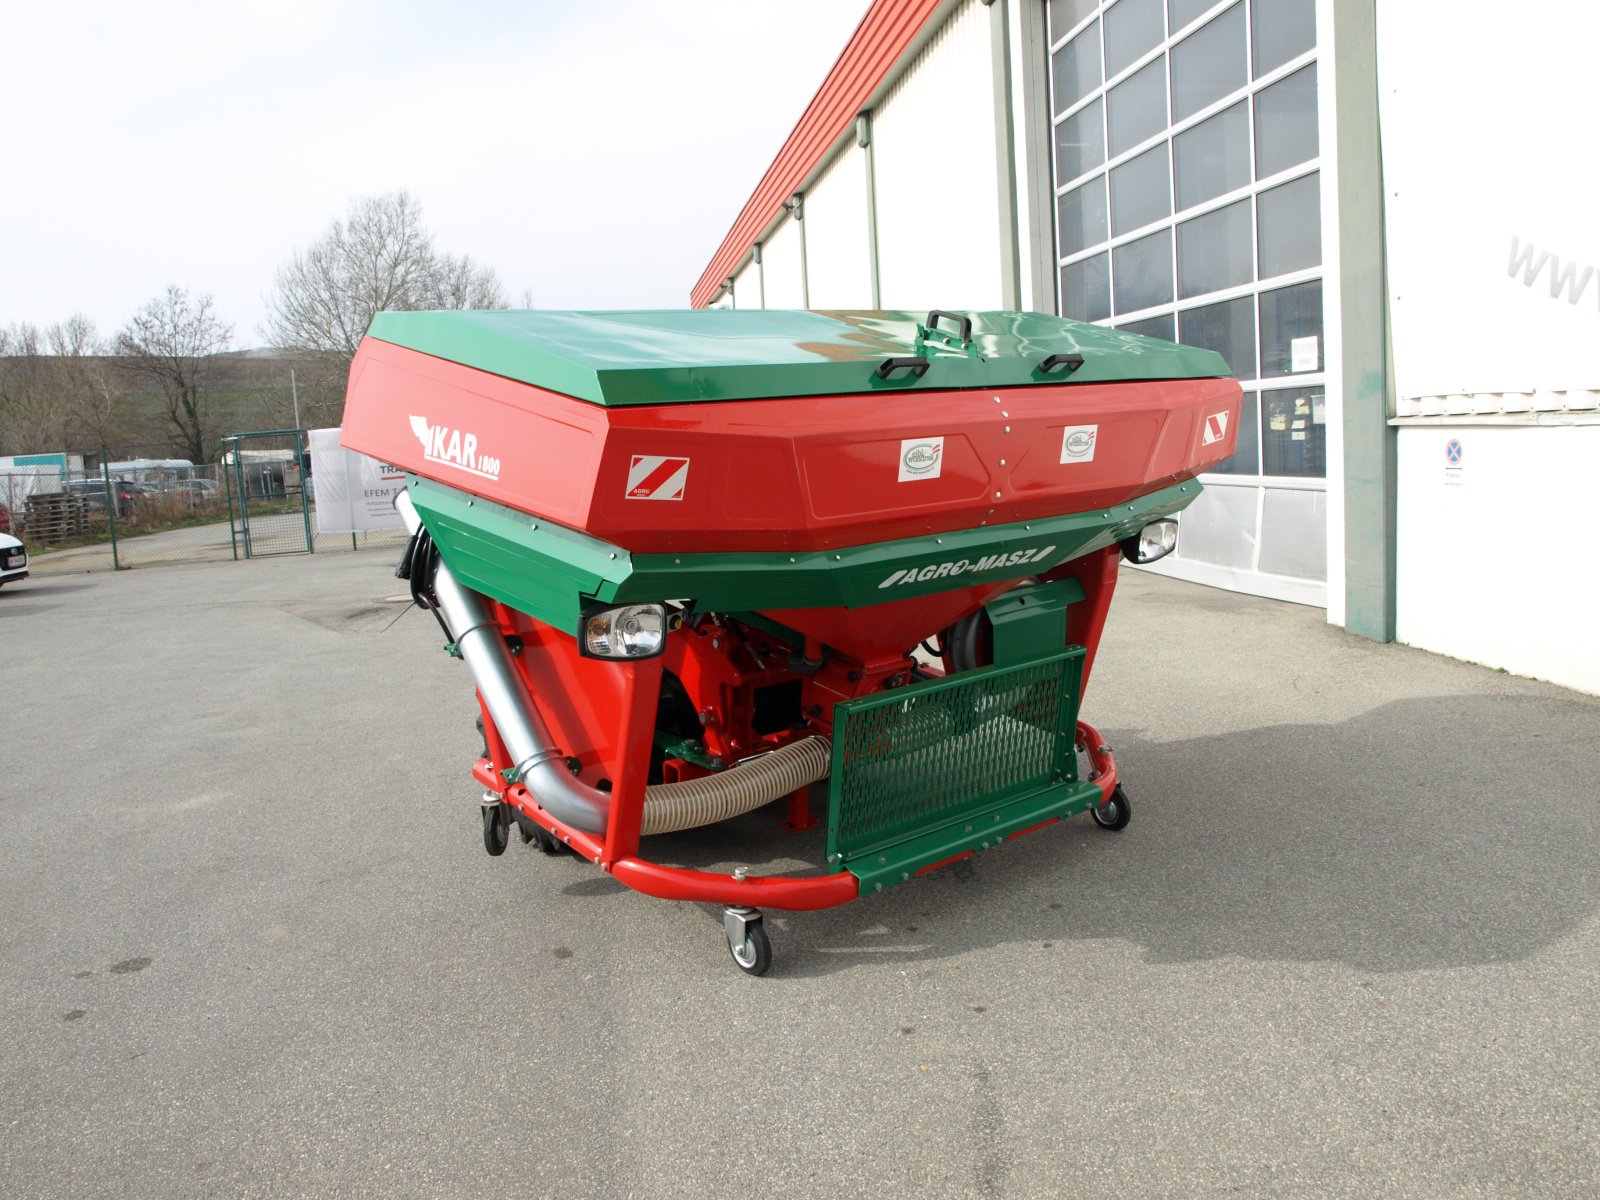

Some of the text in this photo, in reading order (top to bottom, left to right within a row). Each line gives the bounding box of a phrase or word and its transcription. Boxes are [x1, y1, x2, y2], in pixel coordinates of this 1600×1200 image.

[426, 425, 500, 475] IKAR 1800
[364, 489, 390, 498] EFEM
[898, 549, 1038, 585] AGRO-MASZ
